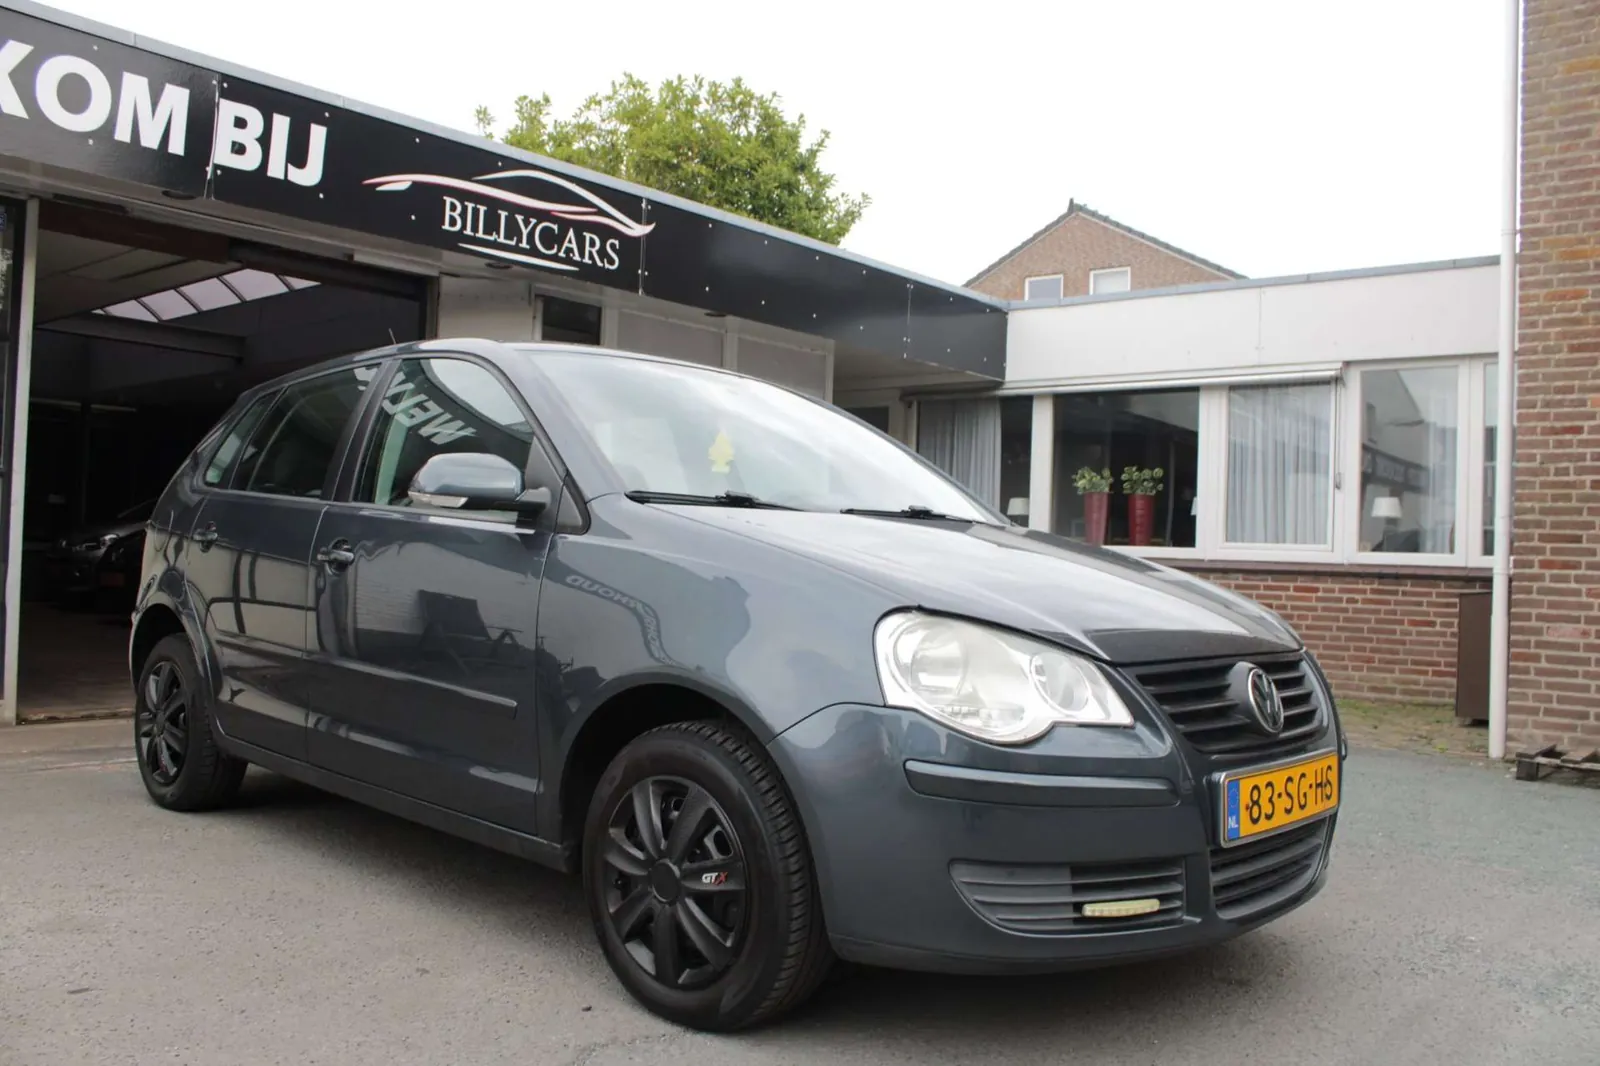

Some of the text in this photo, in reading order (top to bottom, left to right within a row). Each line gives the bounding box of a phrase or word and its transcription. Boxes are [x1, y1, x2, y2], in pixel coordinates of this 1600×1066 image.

[213, 97, 327, 187] BIJ
[441, 196, 620, 271] BILLYCARS
[1227, 815, 1239, 829] NL
[1249, 764, 1333, 825] 83-SG-HS
